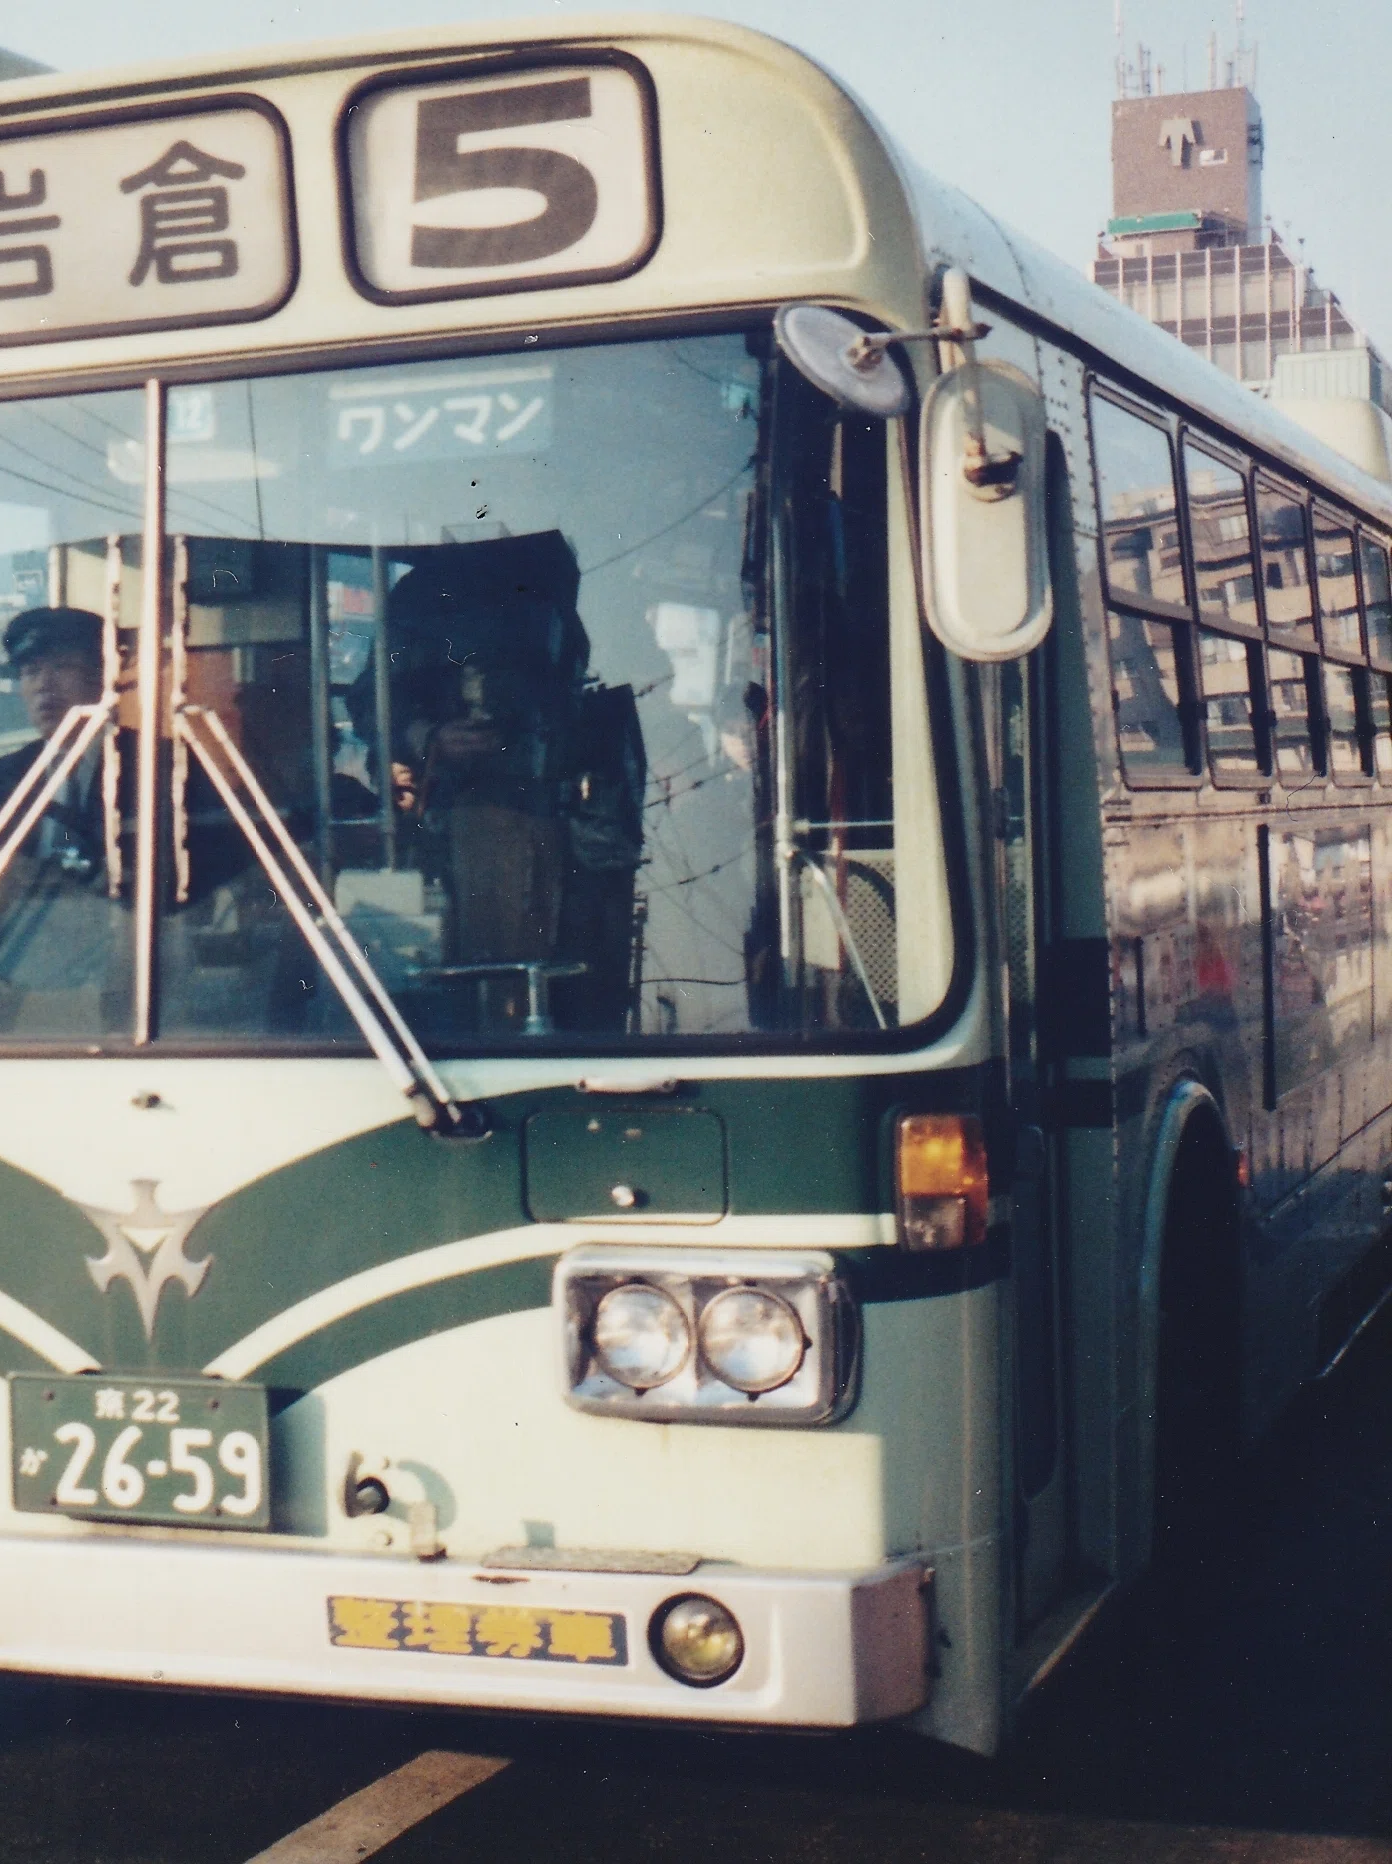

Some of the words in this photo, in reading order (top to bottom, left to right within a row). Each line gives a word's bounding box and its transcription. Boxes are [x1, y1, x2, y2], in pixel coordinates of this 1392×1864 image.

[409, 77, 598, 270] 5
[338, 391, 545, 454] ワンマン
[54, 1421, 263, 1517] 26-59
[332, 1597, 617, 1663] 整理券車
